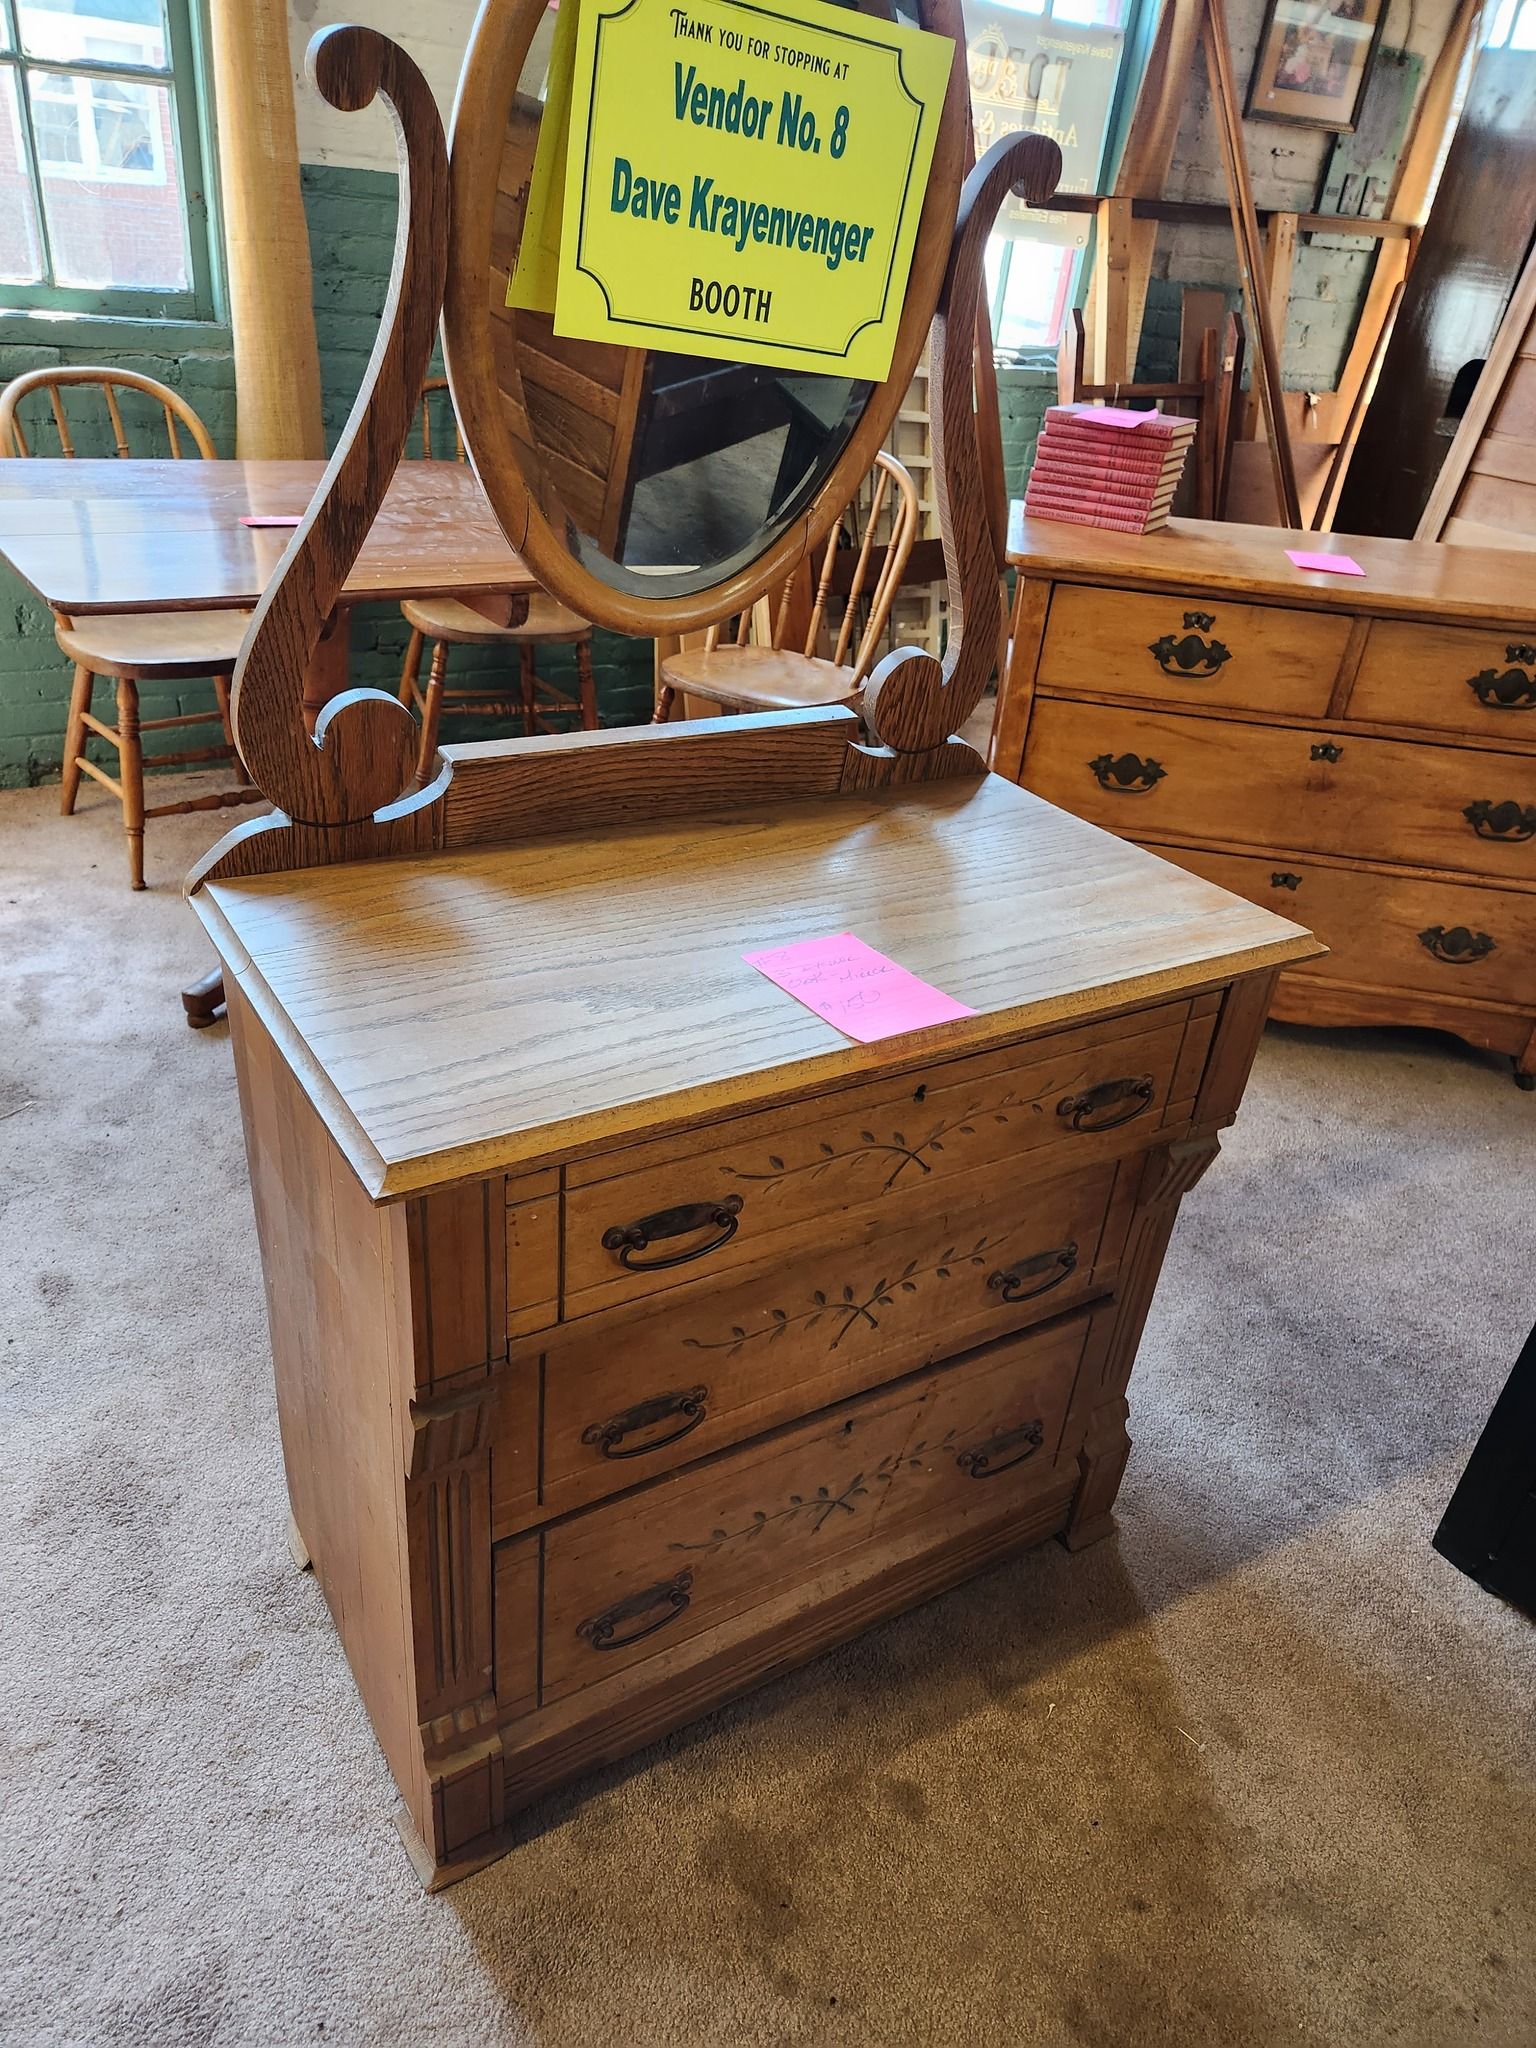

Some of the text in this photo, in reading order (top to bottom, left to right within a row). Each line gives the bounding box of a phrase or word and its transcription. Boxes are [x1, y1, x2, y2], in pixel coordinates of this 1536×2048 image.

[719, 29, 743, 52] YOU
[747, 37, 770, 60] FOR
[773, 45, 831, 76] STOPPING
[833, 61, 850, 81] AT
[673, 61, 850, 160] Vendor No. 8
[610, 157, 874, 271] Dave Krayenvenger
[689, 278, 772, 324] BOOTH
